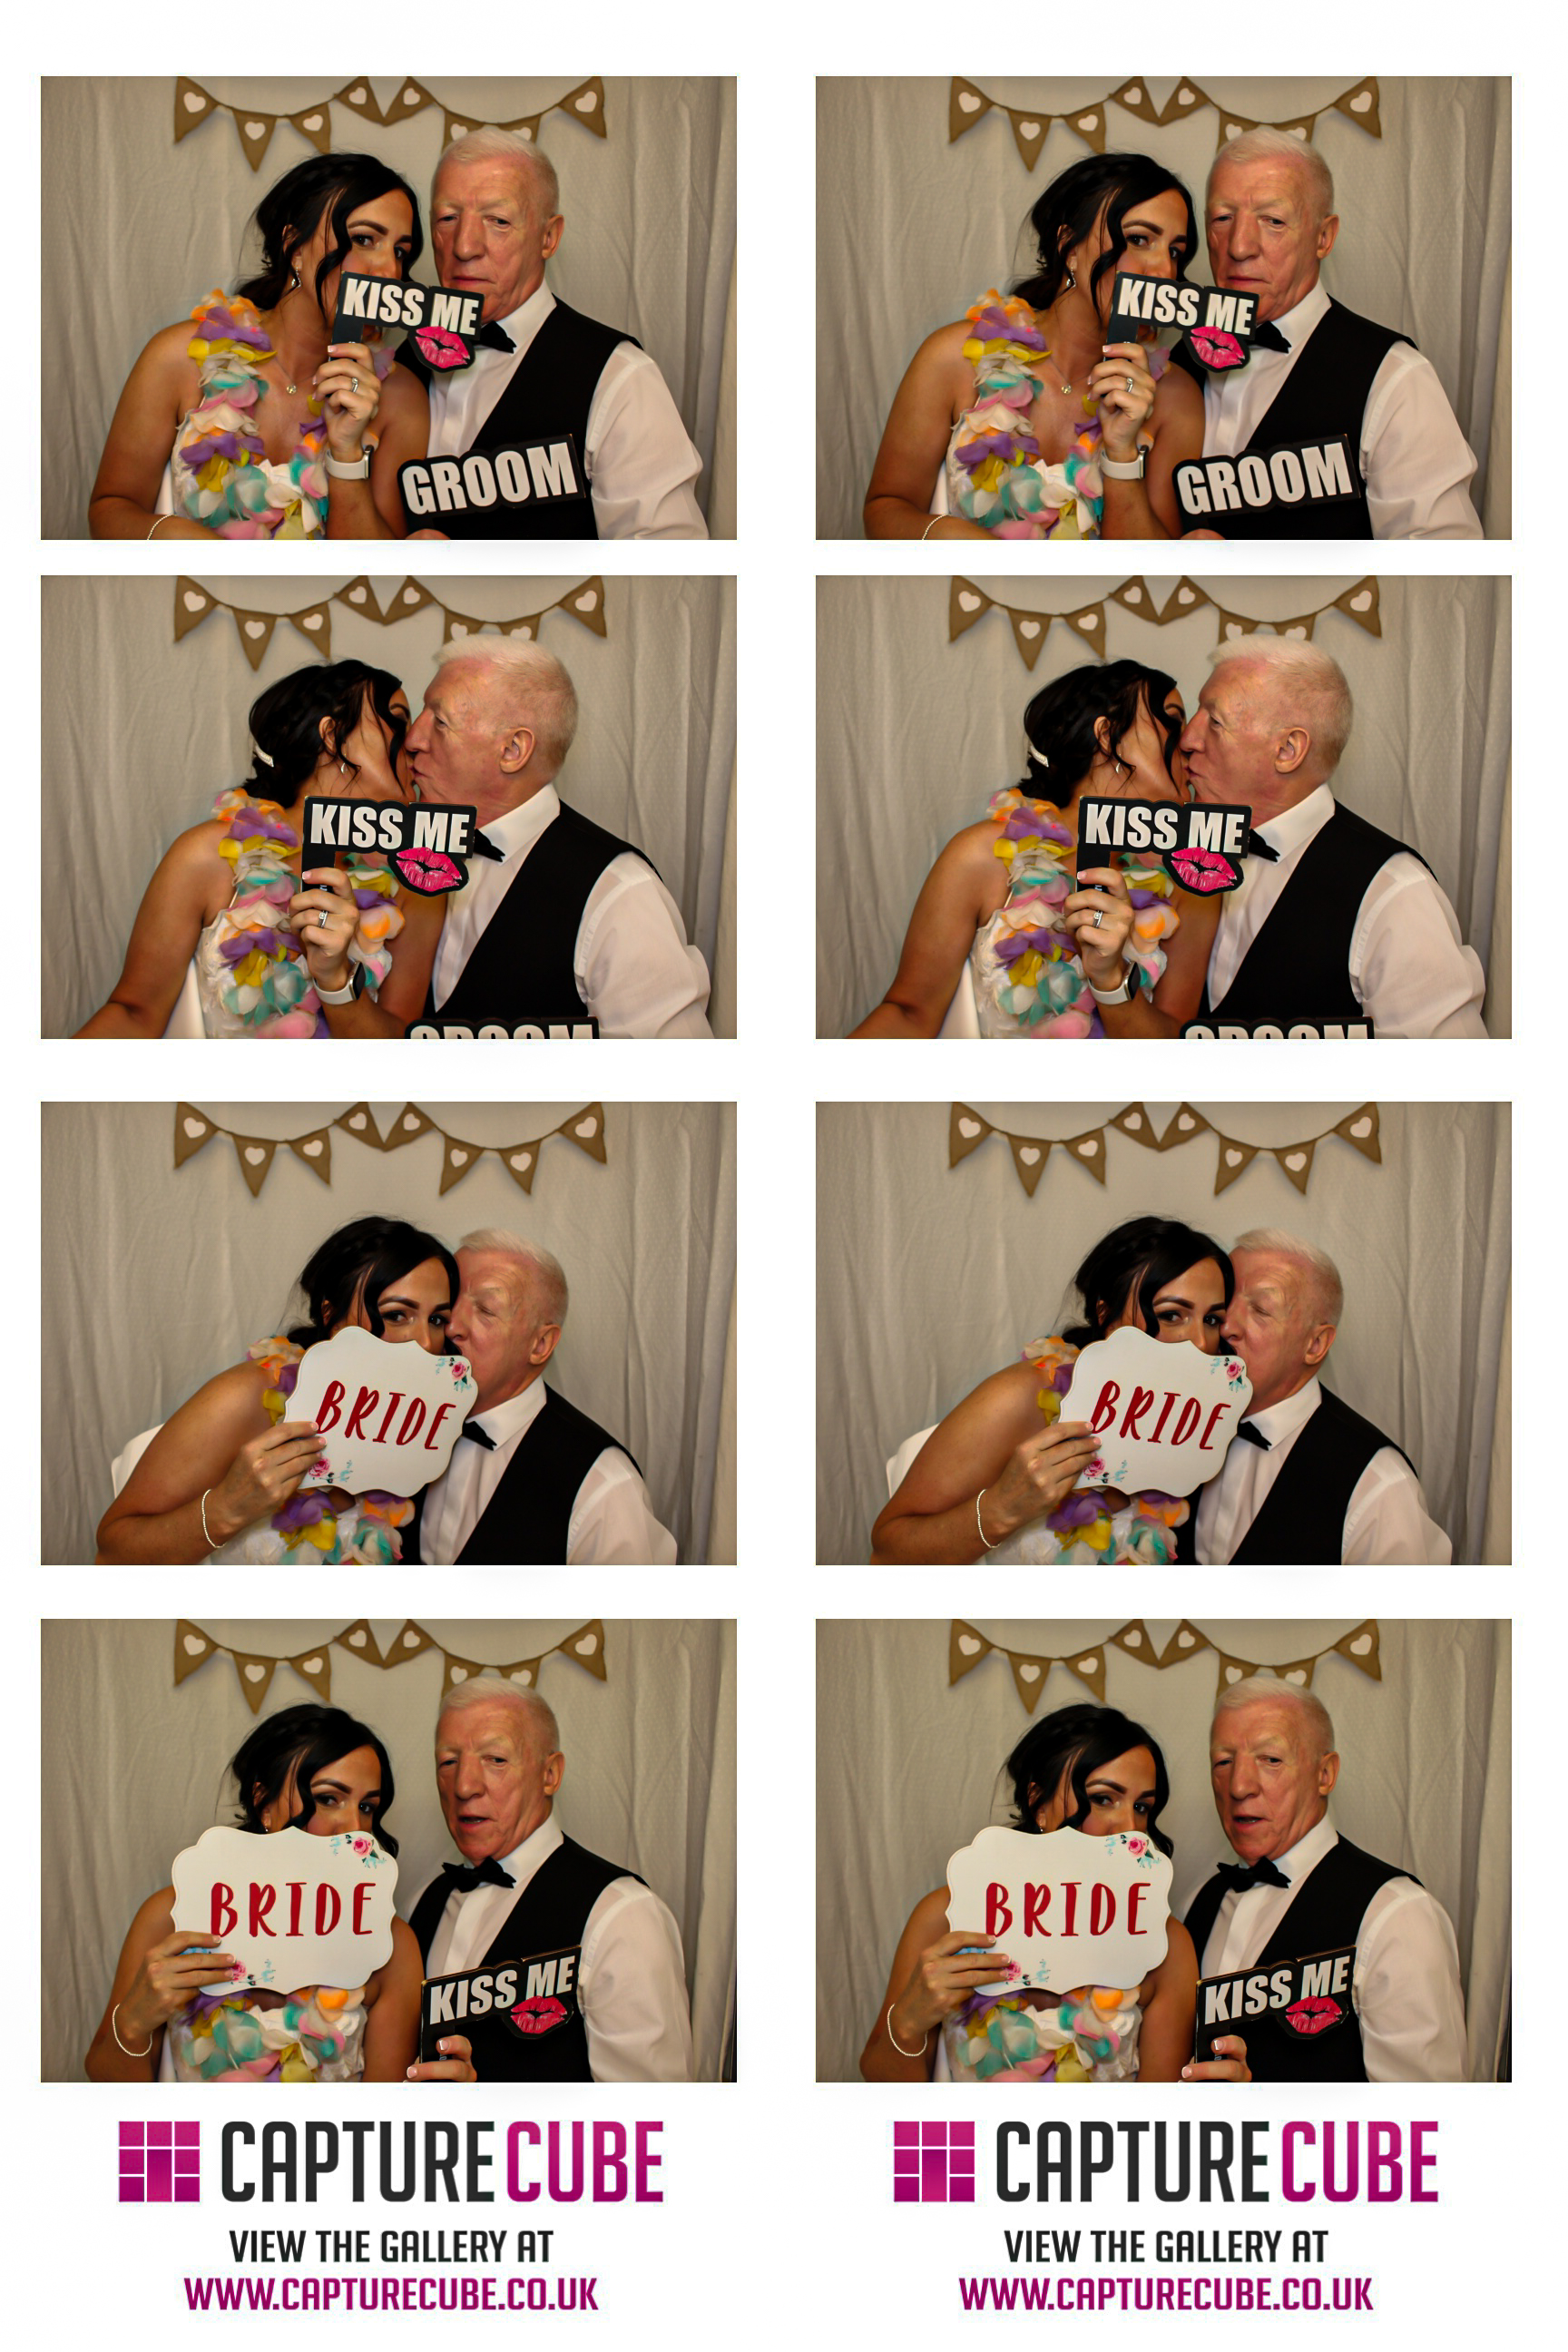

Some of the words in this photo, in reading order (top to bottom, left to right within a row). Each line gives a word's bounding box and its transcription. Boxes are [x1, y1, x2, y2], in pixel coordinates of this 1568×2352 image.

[342, 278, 426, 328] KISS
[430, 292, 480, 337] ME
[1117, 278, 1200, 328] KISS
[1205, 292, 1255, 337] ME
[402, 442, 578, 514] GROOM
[1177, 442, 1353, 514] GROOM
[310, 803, 405, 850] KISS
[412, 810, 470, 854] ME
[1085, 803, 1180, 850] KISS
[1187, 810, 1245, 854] ME
[315, 1379, 456, 1450] BRIDE
[1090, 1379, 1231, 1450] BRIDE
[210, 1881, 377, 1937] BRIDE
[985, 1881, 1152, 1937] BRIDE
[429, 1968, 518, 2025] KISS
[524, 1955, 576, 2001] ME
[1204, 1968, 1293, 2025] KISS
[1299, 1955, 1351, 2001] ME
